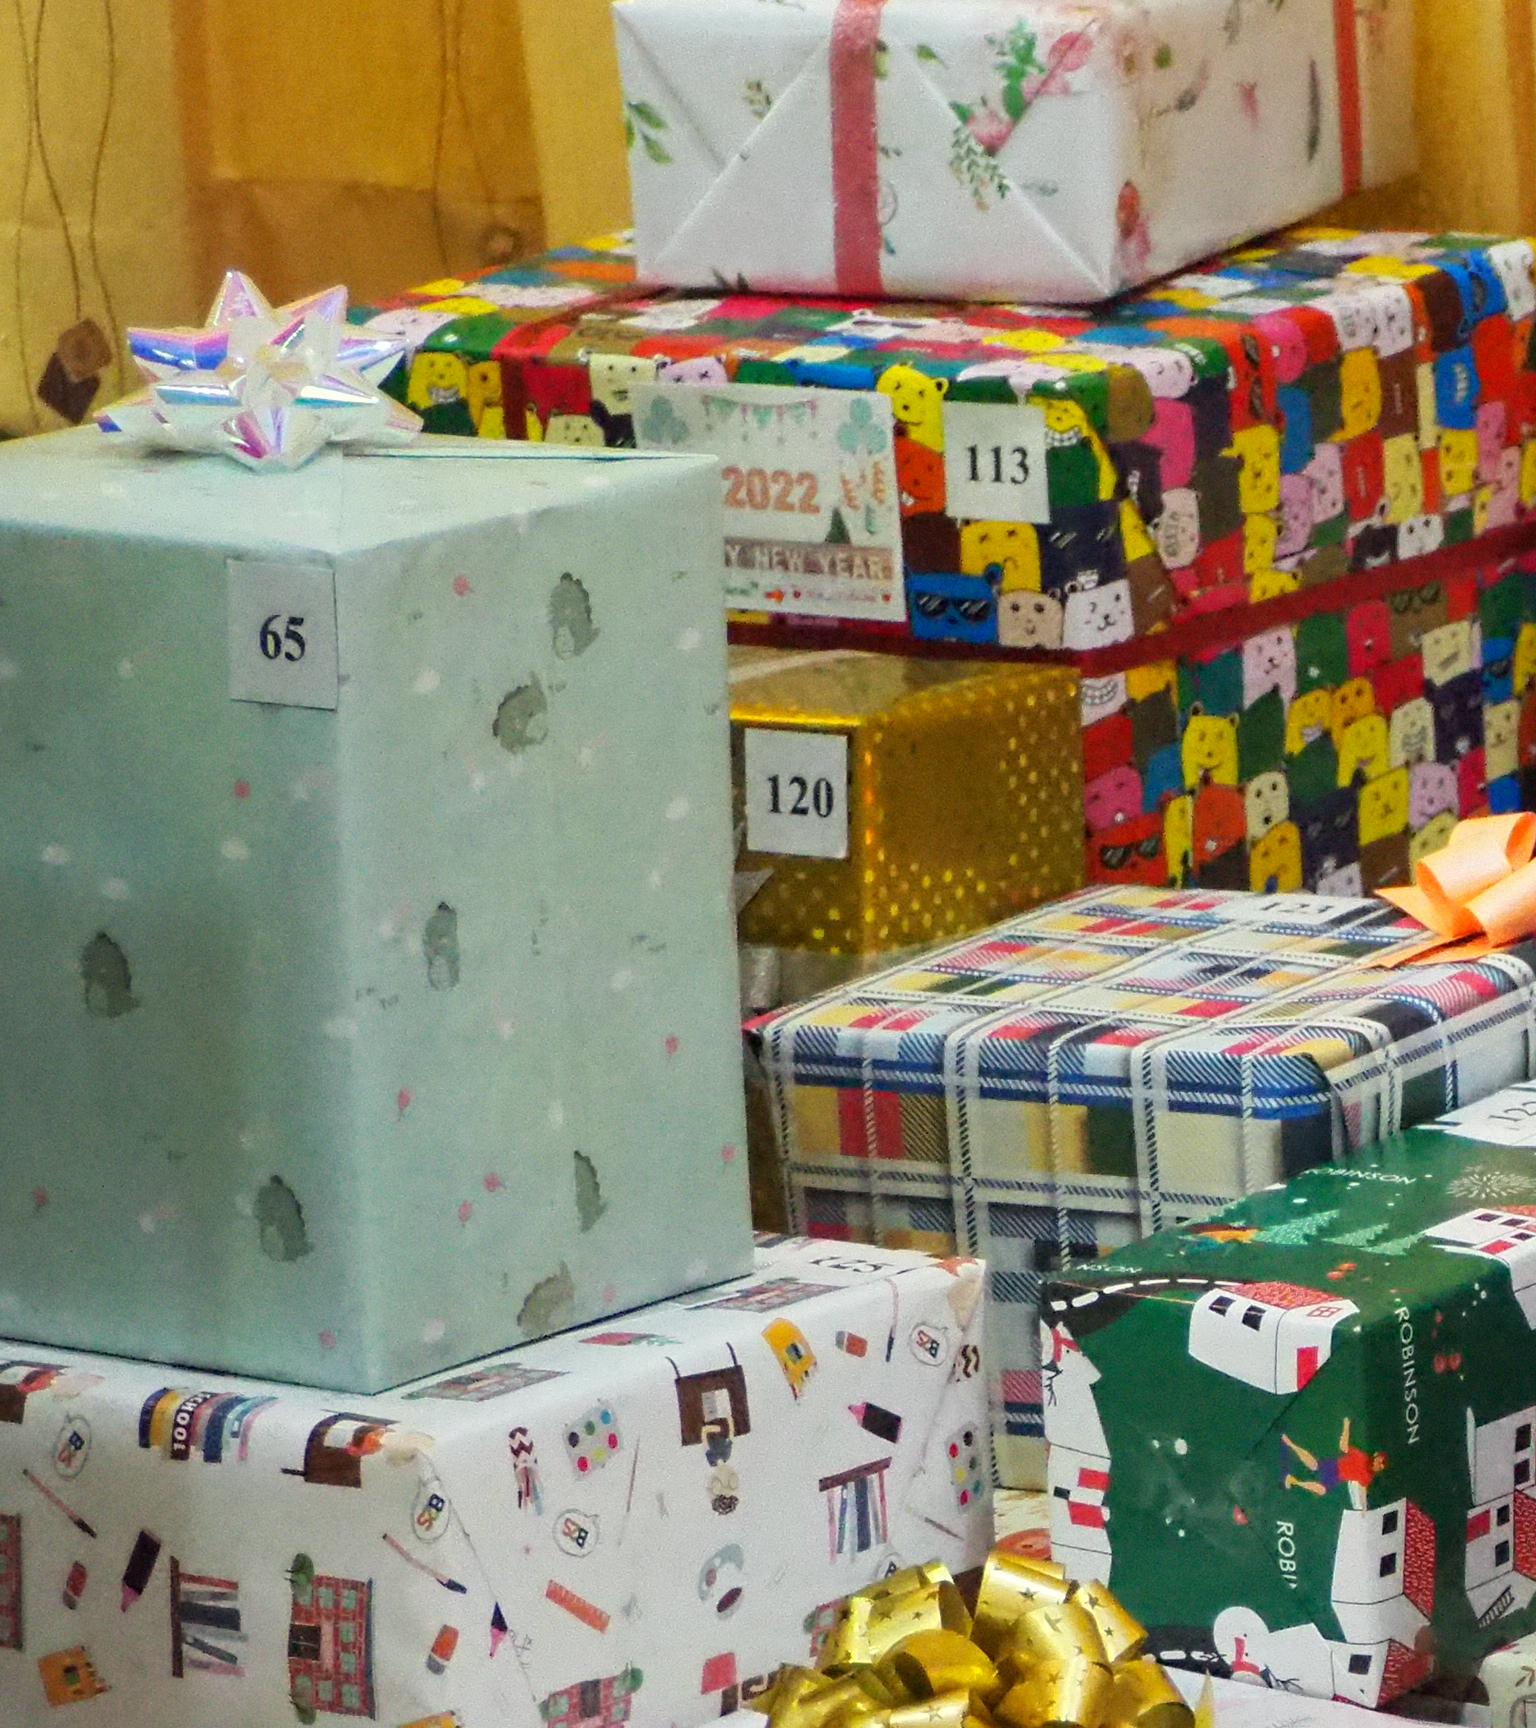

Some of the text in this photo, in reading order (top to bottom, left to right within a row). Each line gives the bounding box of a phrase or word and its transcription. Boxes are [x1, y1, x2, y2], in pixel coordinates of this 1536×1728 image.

[966, 444, 1031, 485] 113
[721, 465, 821, 515] 2022
[820, 549, 889, 580] YEAR
[259, 613, 307, 661] 65
[766, 774, 835, 819] 120
[809, 1256, 893, 1275] 125
[1395, 1306, 1420, 1445] ROBINSON
